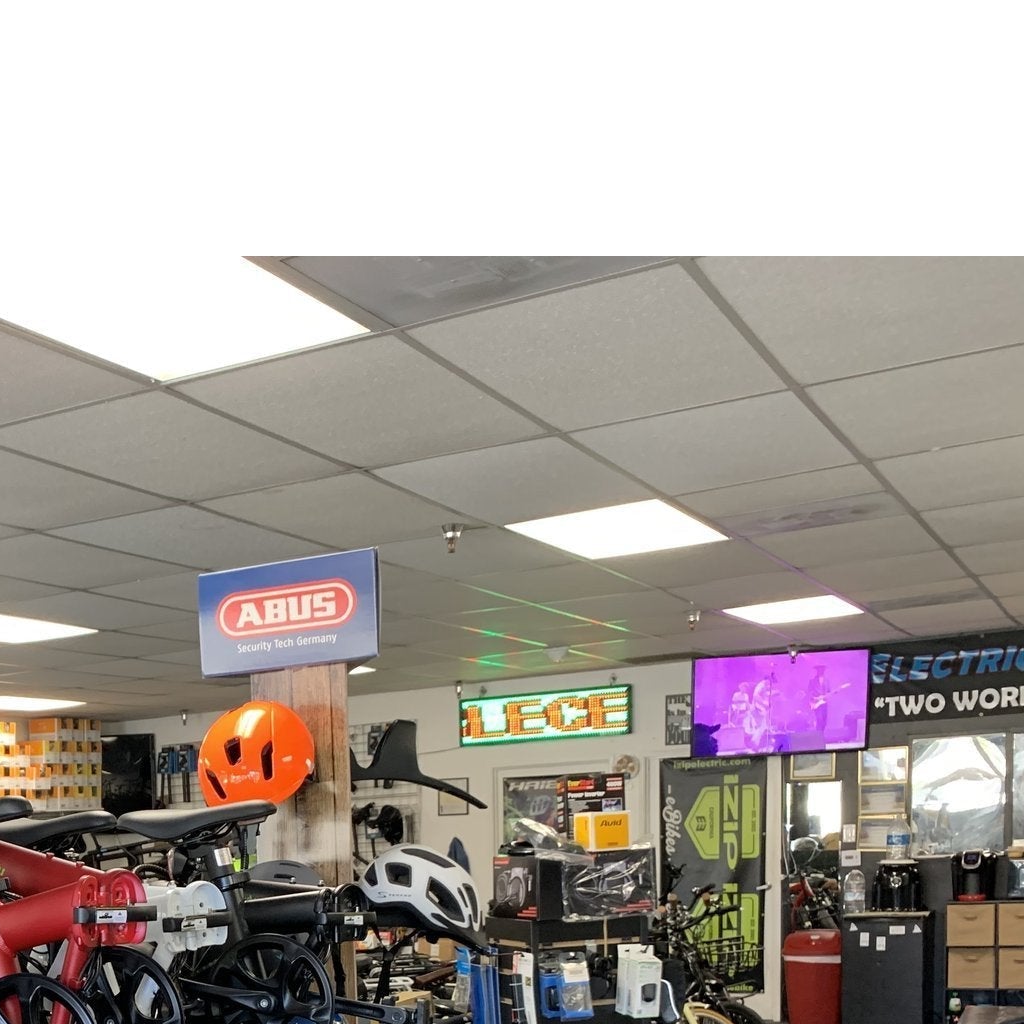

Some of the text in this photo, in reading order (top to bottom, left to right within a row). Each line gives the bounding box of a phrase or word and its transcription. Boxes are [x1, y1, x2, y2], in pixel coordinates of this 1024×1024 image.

[236, 591, 336, 628] ABUS
[237, 634, 337, 653] Security Tech Germany
[952, 686, 1024, 712] WOR
[723, 774, 739, 870] IZIP
